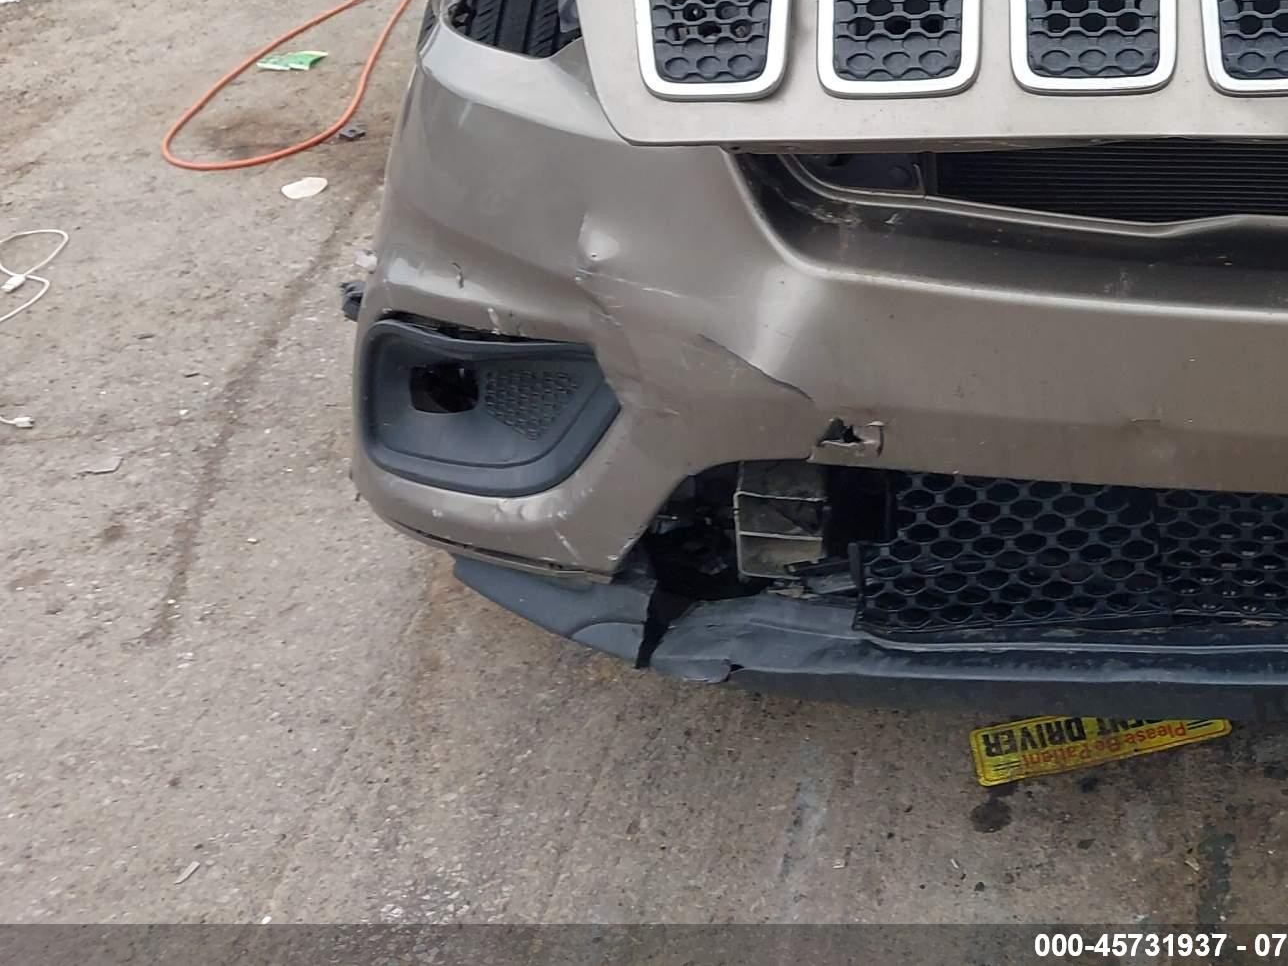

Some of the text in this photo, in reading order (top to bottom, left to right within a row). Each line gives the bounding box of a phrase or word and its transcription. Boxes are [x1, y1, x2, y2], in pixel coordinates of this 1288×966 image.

[983, 718, 1086, 757] DRIVER
[1095, 736, 1121, 753] Be
[1125, 721, 1187, 745] Please
